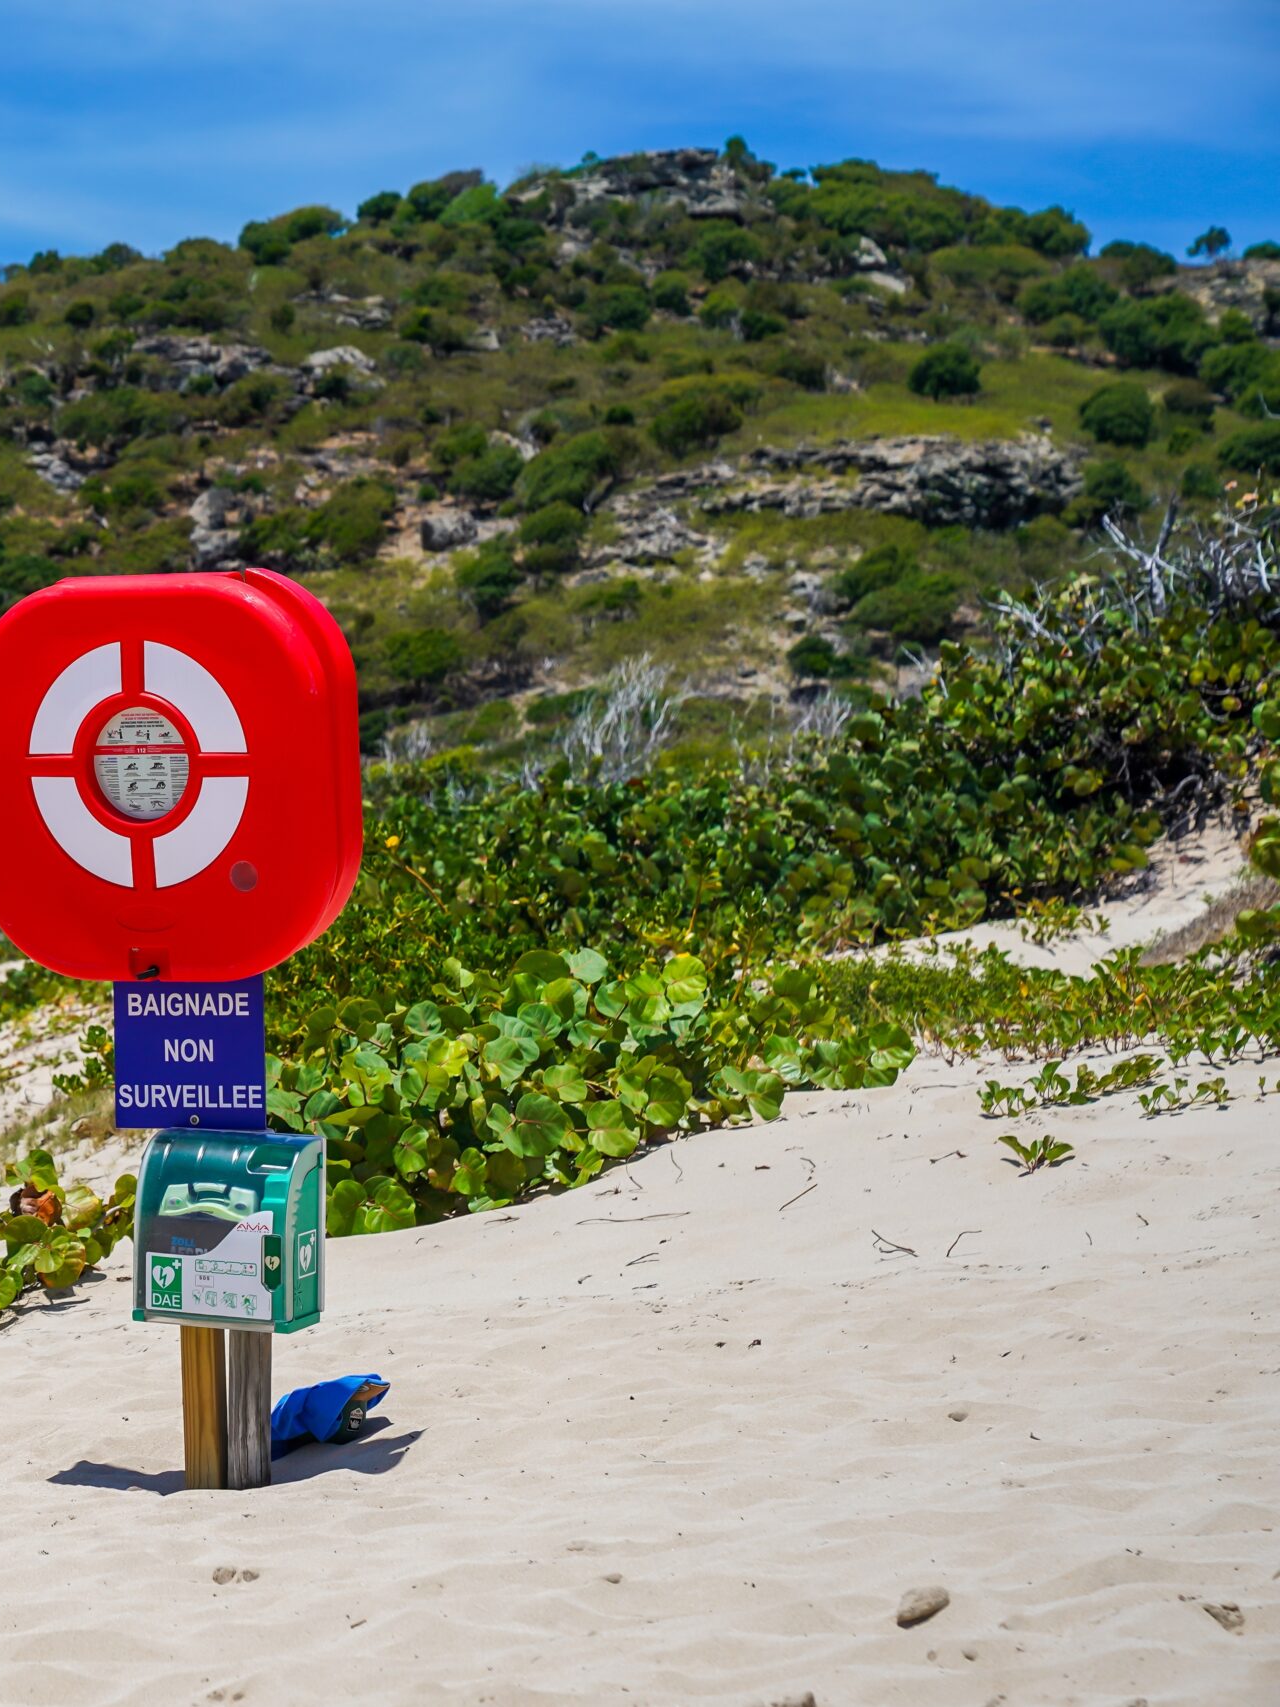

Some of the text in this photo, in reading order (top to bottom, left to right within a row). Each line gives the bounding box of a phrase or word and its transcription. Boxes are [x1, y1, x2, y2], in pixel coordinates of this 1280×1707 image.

[127, 992, 250, 1017] BAIGNADE
[164, 1038, 214, 1062] NON
[118, 1084, 263, 1109] SURVEILLEE
[152, 1292, 181, 1307] DAE
